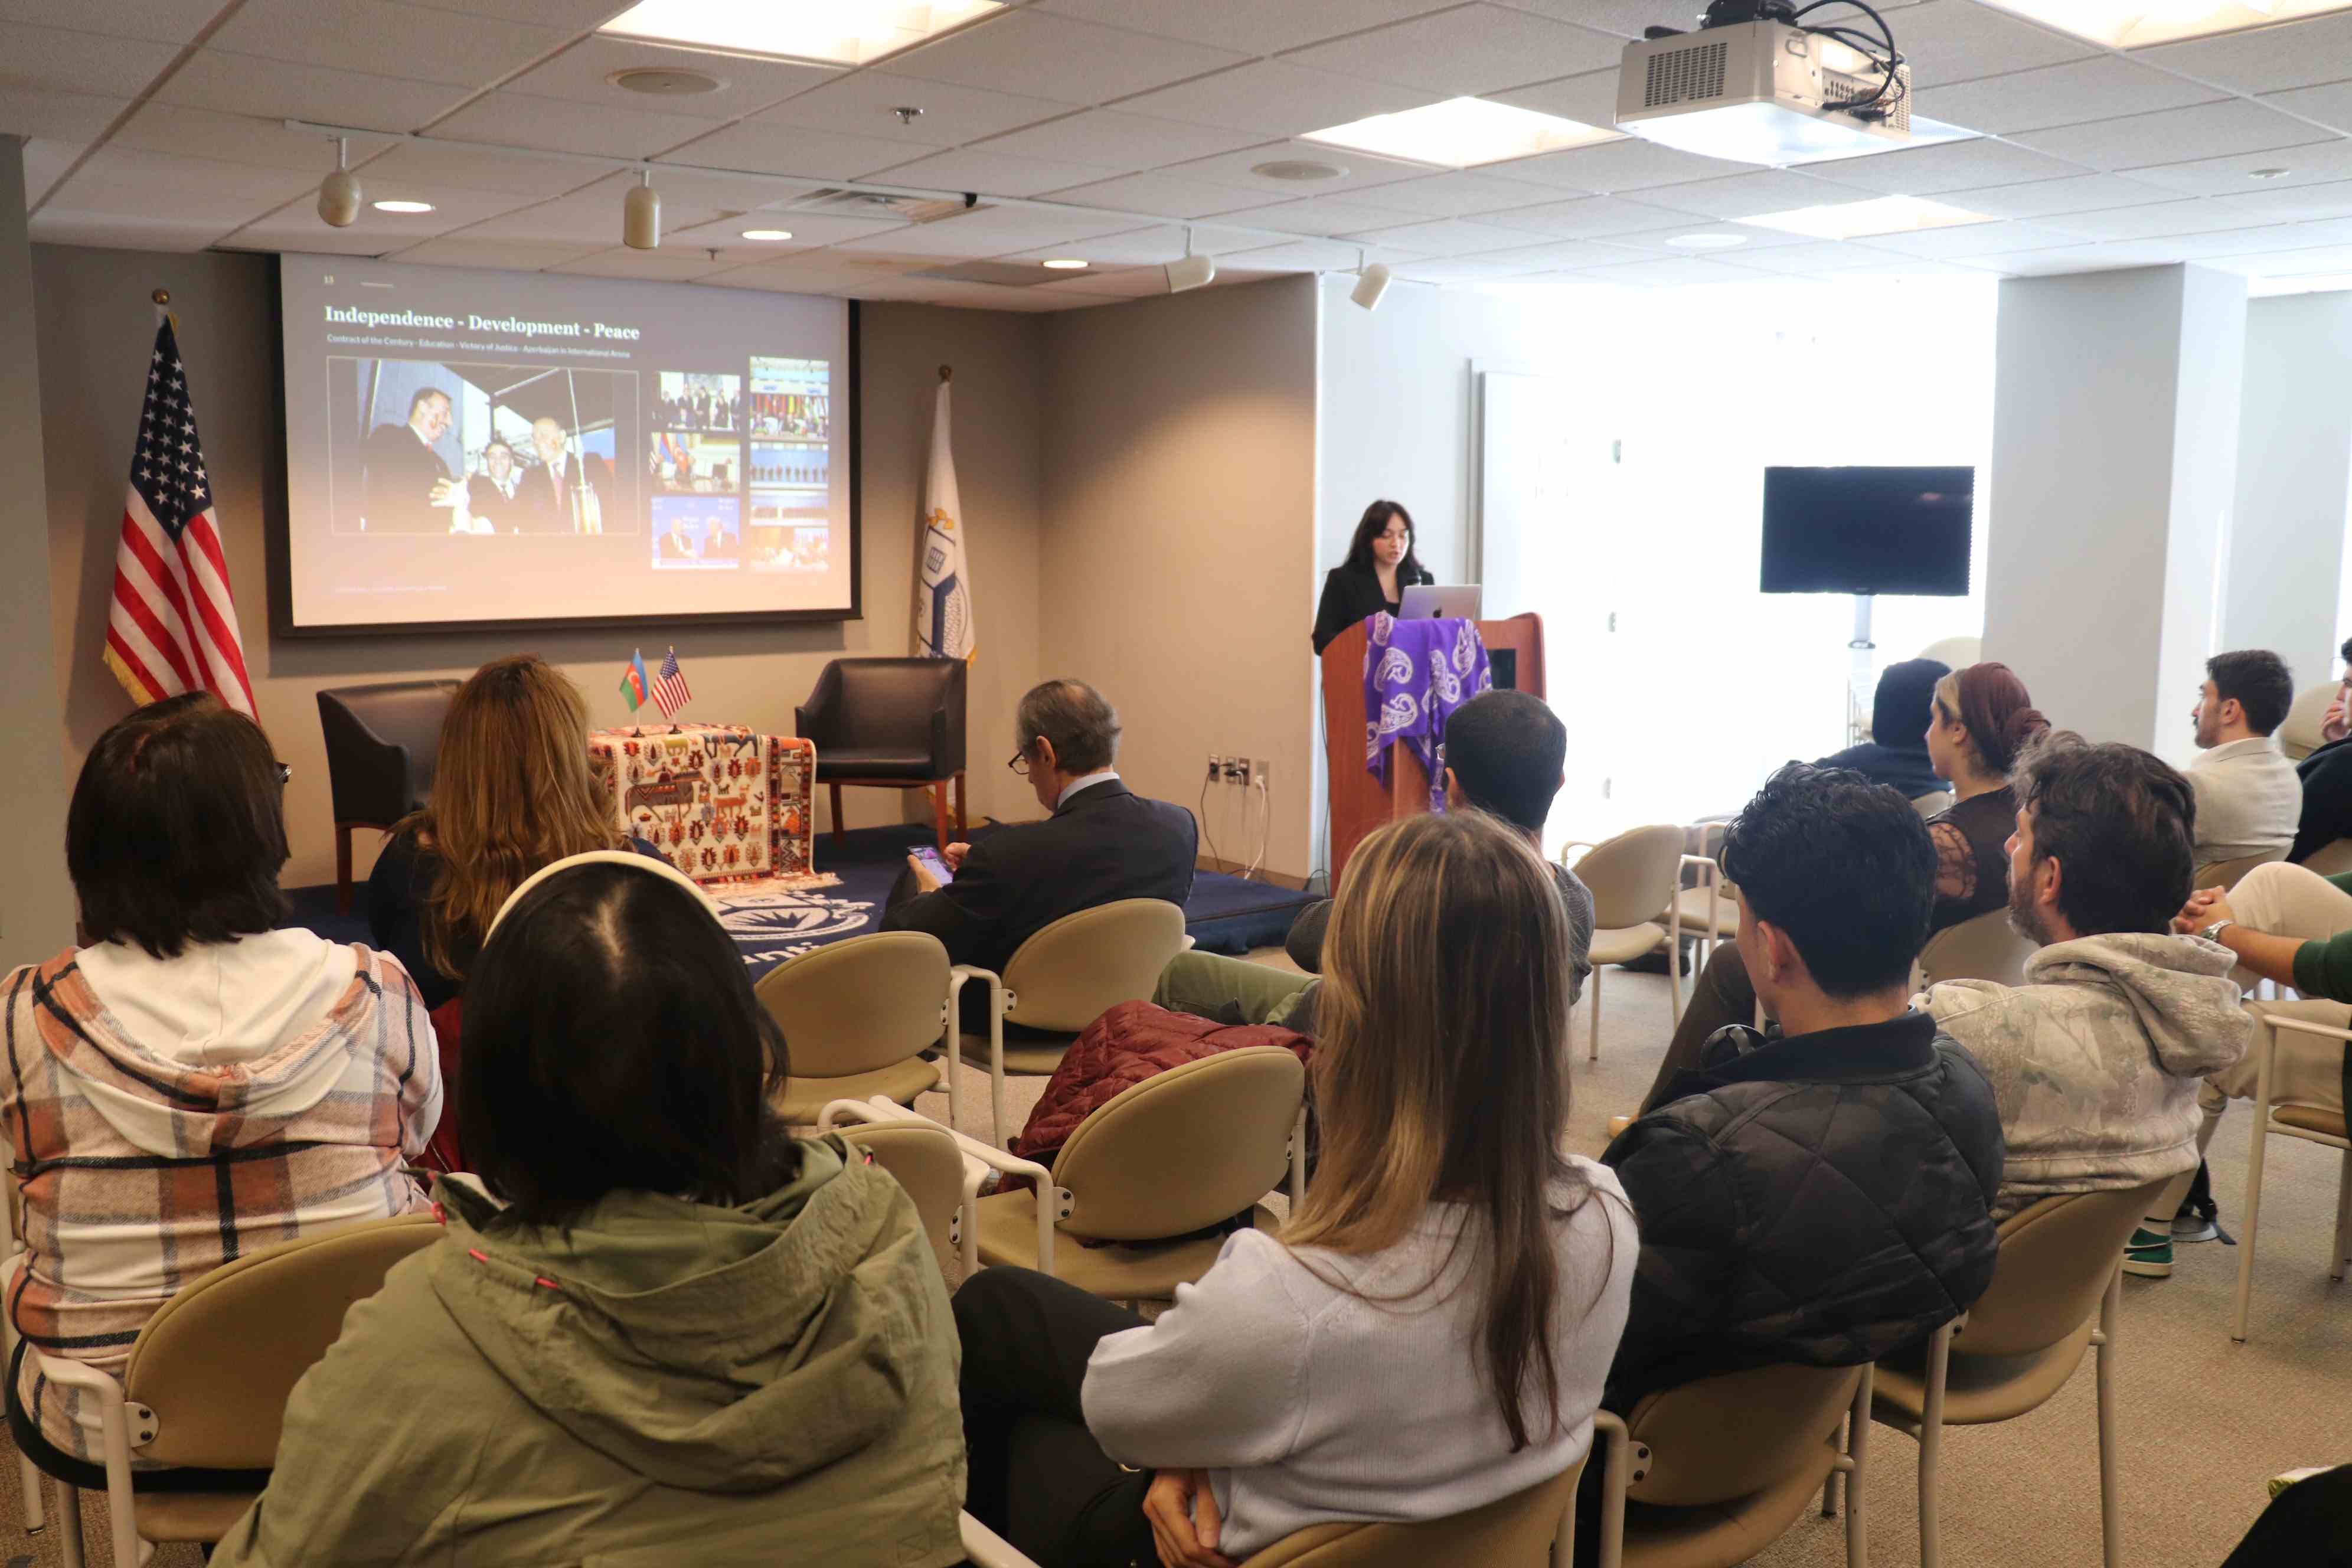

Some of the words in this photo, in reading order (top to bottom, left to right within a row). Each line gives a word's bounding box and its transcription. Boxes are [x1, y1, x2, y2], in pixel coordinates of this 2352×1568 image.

[325, 305, 454, 328] Independence
[468, 315, 580, 337] Development
[593, 322, 640, 340] Peace
[326, 334, 360, 344] Contract
[370, 337, 383, 345] the
[384, 337, 413, 348] Century
[419, 338, 454, 349] Education
[459, 341, 485, 351] Victory
[495, 343, 518, 352] Justice
[523, 345, 558, 356] Azerbaijan
